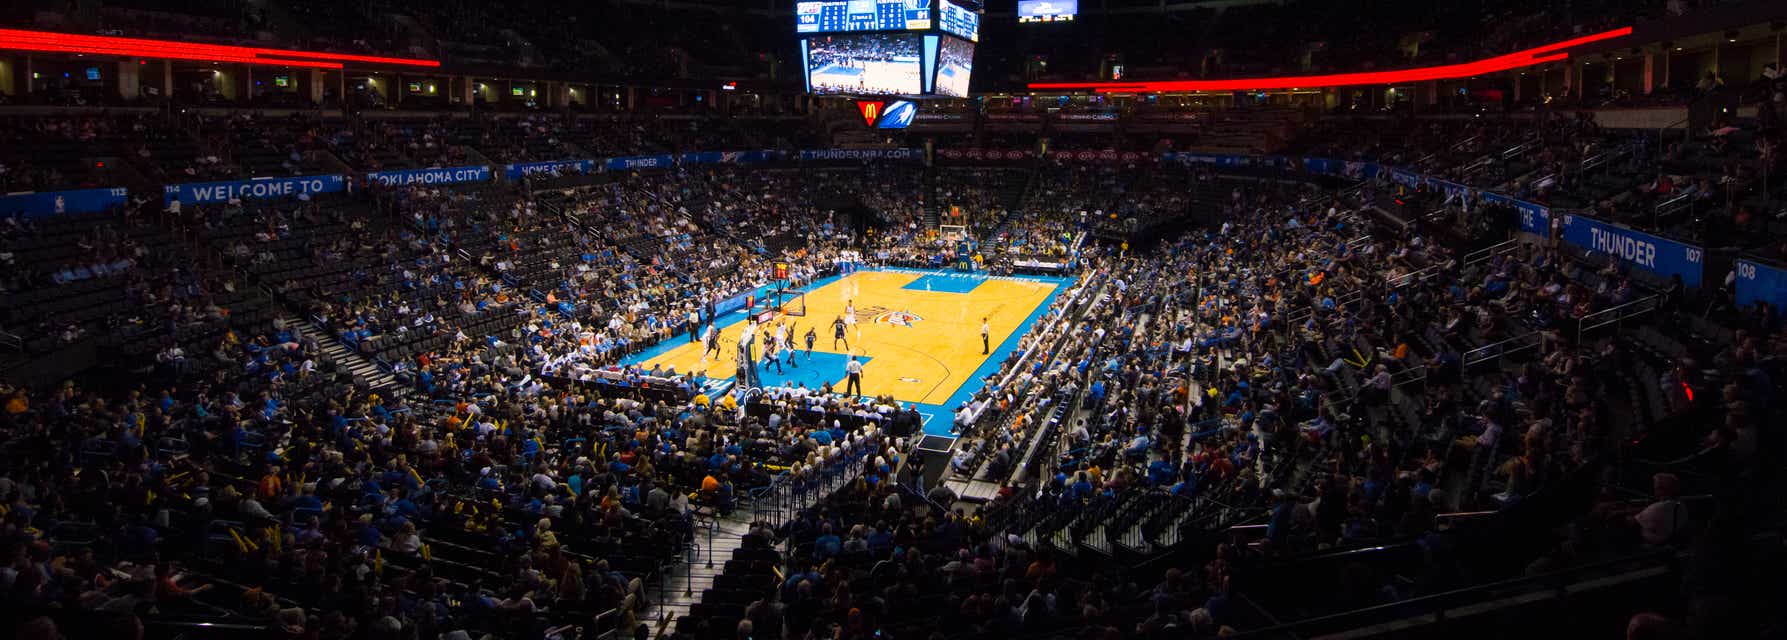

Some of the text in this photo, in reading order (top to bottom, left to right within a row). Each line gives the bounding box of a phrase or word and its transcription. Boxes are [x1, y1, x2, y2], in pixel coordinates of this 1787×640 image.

[800, 15, 815, 24] 104
[917, 10, 928, 19] 91
[625, 158, 657, 168] THUNDER
[332, 175, 343, 183] 114
[379, 169, 481, 186] OKLAHOMA CITY
[165, 184, 180, 193] 114
[193, 180, 323, 201] WELCOME TO
[1518, 206, 1534, 228] THE
[1590, 227, 1656, 269] THUNDER
[1686, 247, 1701, 264] 107
[1737, 262, 1756, 280] 108
